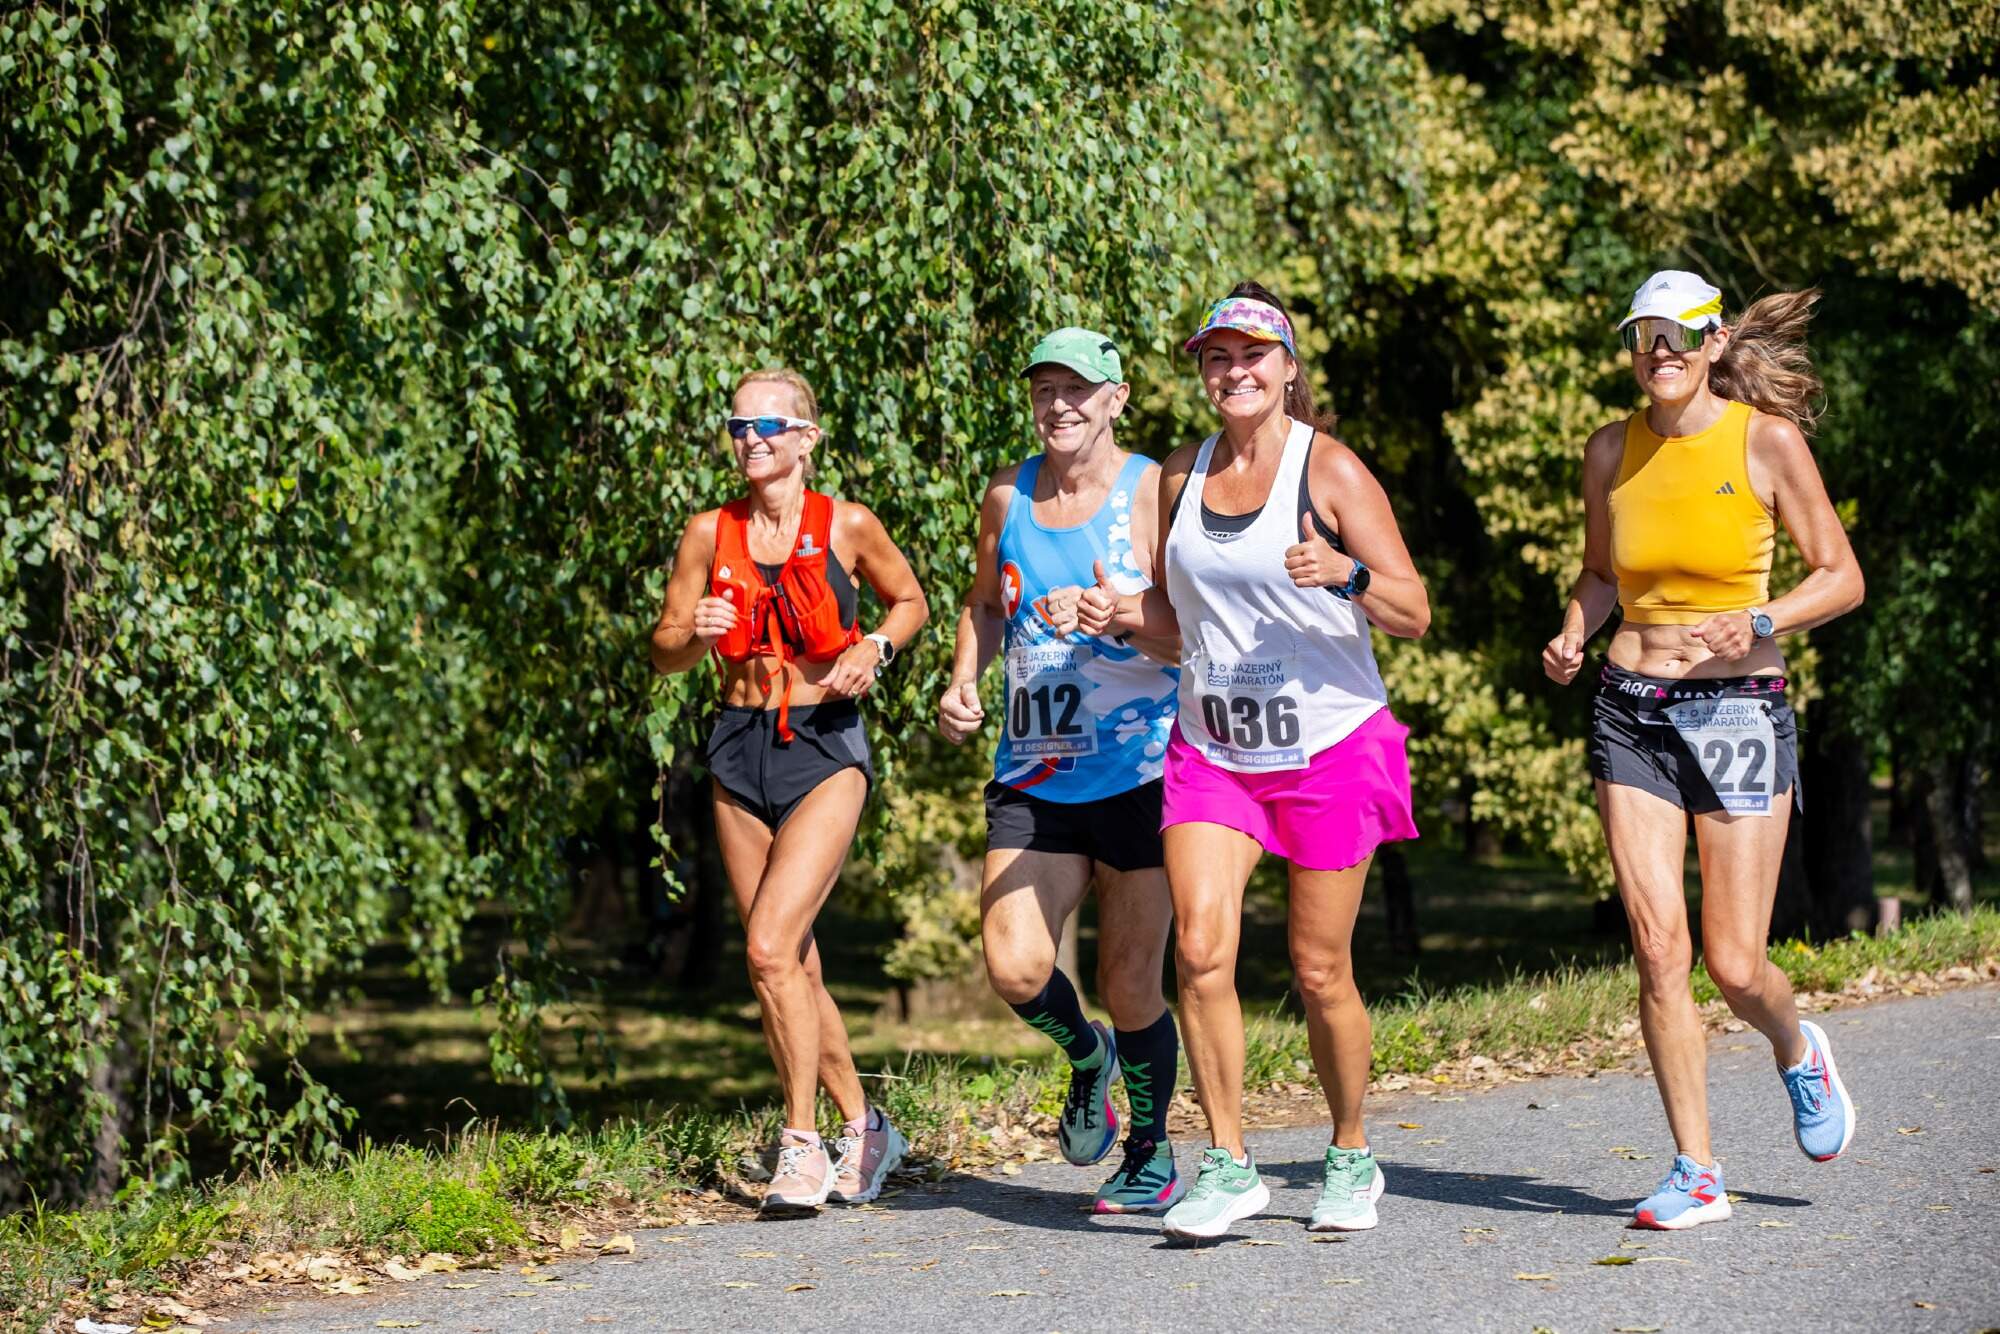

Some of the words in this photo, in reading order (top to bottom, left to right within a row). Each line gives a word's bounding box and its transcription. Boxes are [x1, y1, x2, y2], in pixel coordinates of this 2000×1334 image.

[1231, 660, 1283, 675] JAZERNÝ
[1231, 673, 1284, 686] MARATÓN
[1012, 683, 1083, 738] 012
[1703, 702, 1756, 715] JAZERNÝ
[1201, 694, 1300, 749] 036
[1702, 714, 1758, 727] MARATÓN
[1686, 738, 1767, 793] 22
